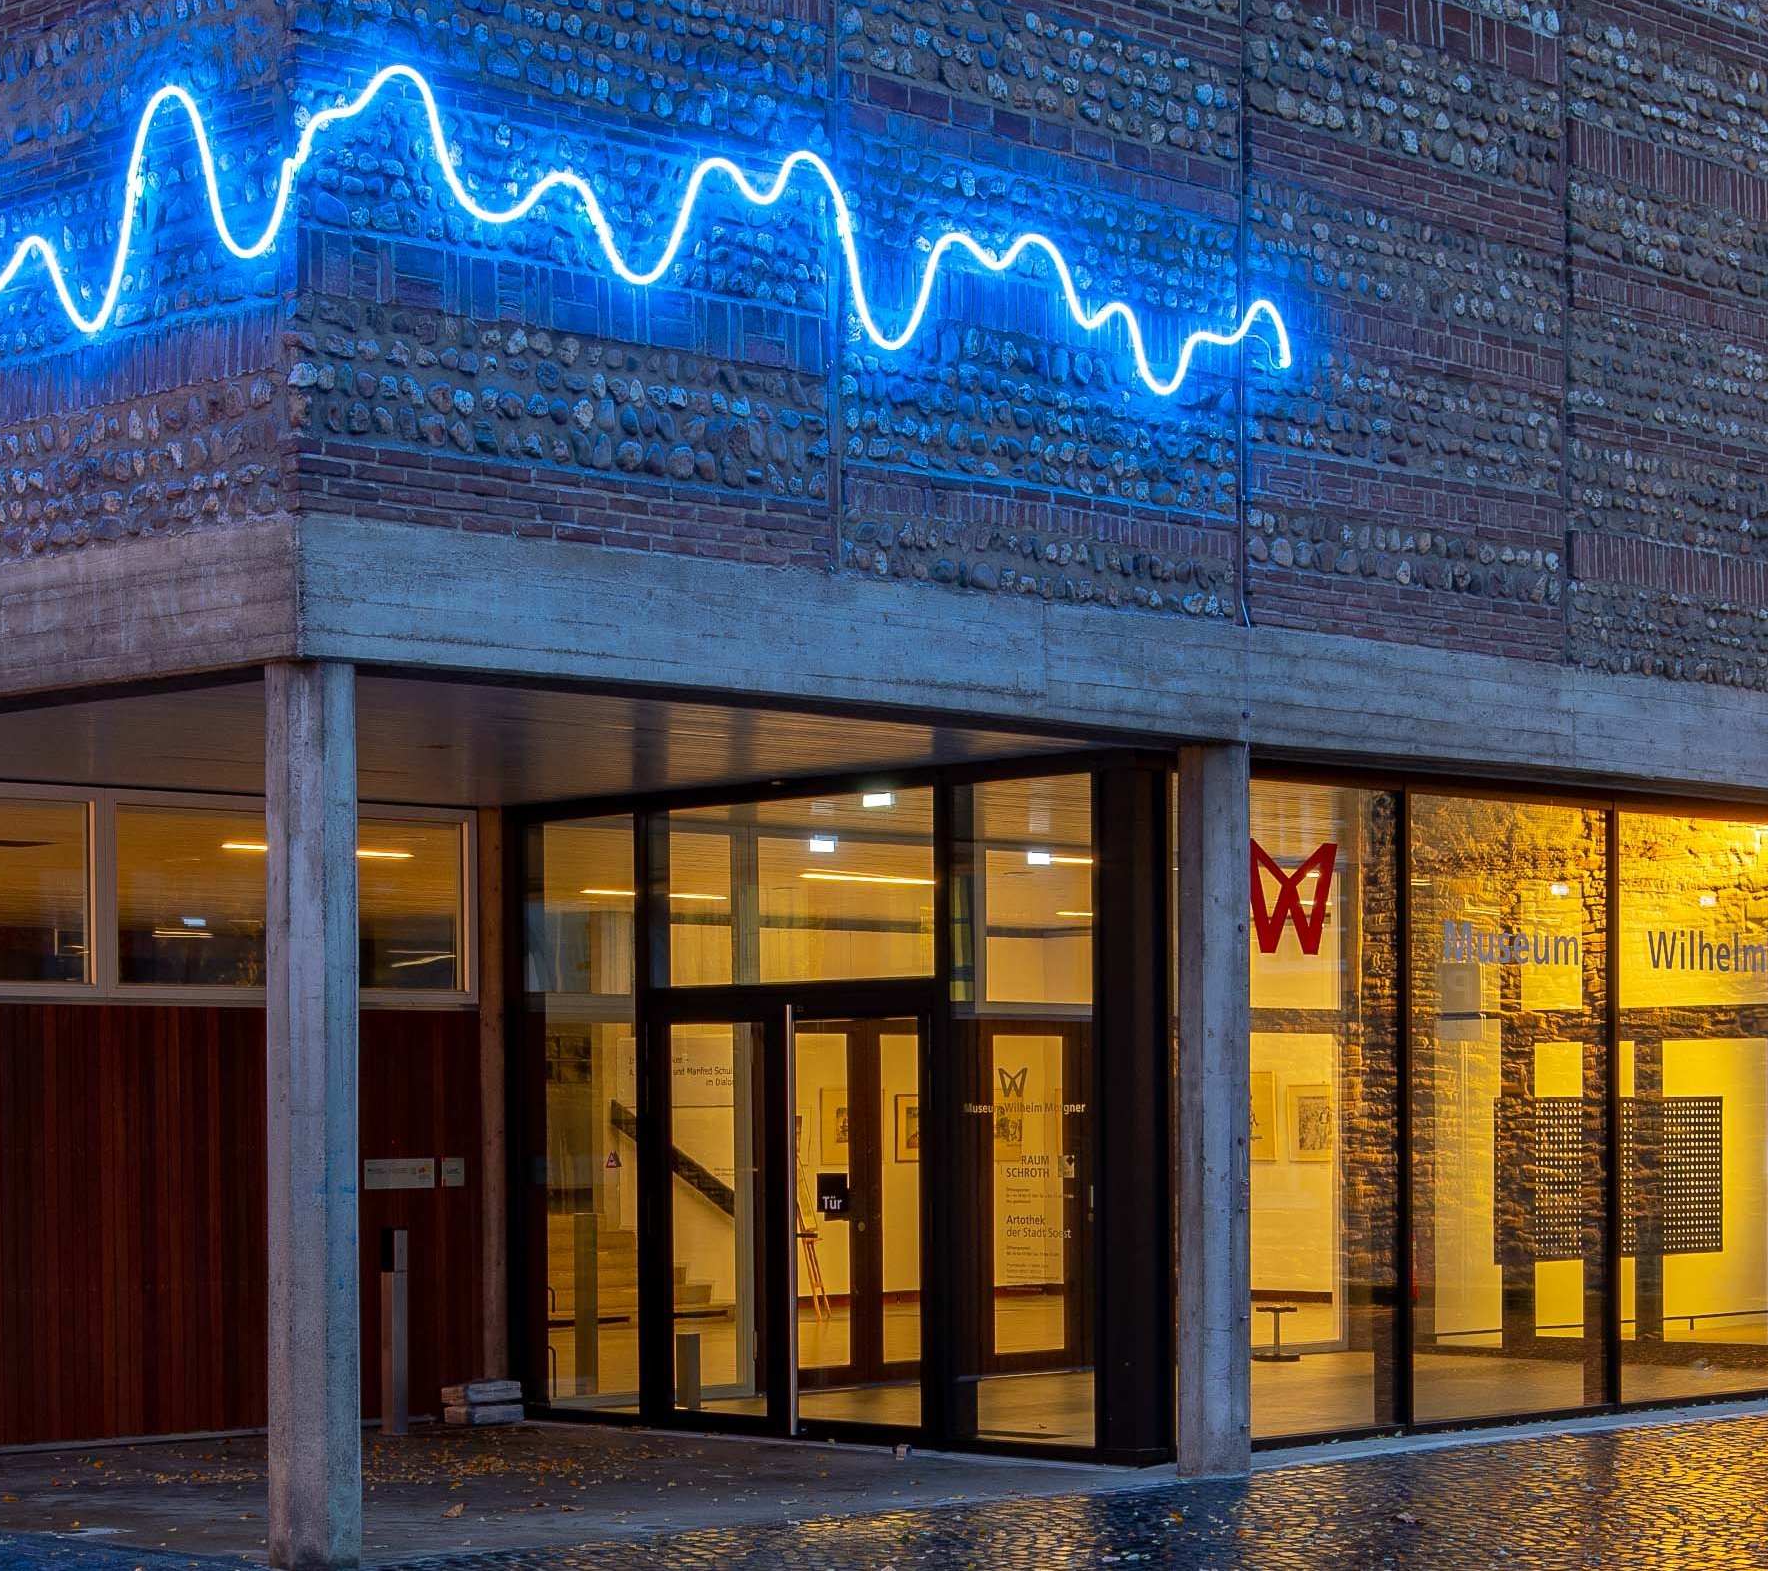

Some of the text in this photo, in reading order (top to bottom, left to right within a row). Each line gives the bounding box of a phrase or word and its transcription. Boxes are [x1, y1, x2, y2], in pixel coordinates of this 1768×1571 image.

[1444, 919, 1578, 966] Museum
[1648, 930, 1766, 972] Wilhelm
[714, 1066, 734, 1075] Schul
[1004, 1102, 1042, 1113] Wilhelm
[1021, 1155, 1049, 1165] RAUM
[1006, 1168, 1050, 1178] SCHROTH
[822, 1195, 842, 1210] Tür
[1006, 1215, 1045, 1225] Artothek
[1006, 1227, 1072, 1239] der Stadt Soest
